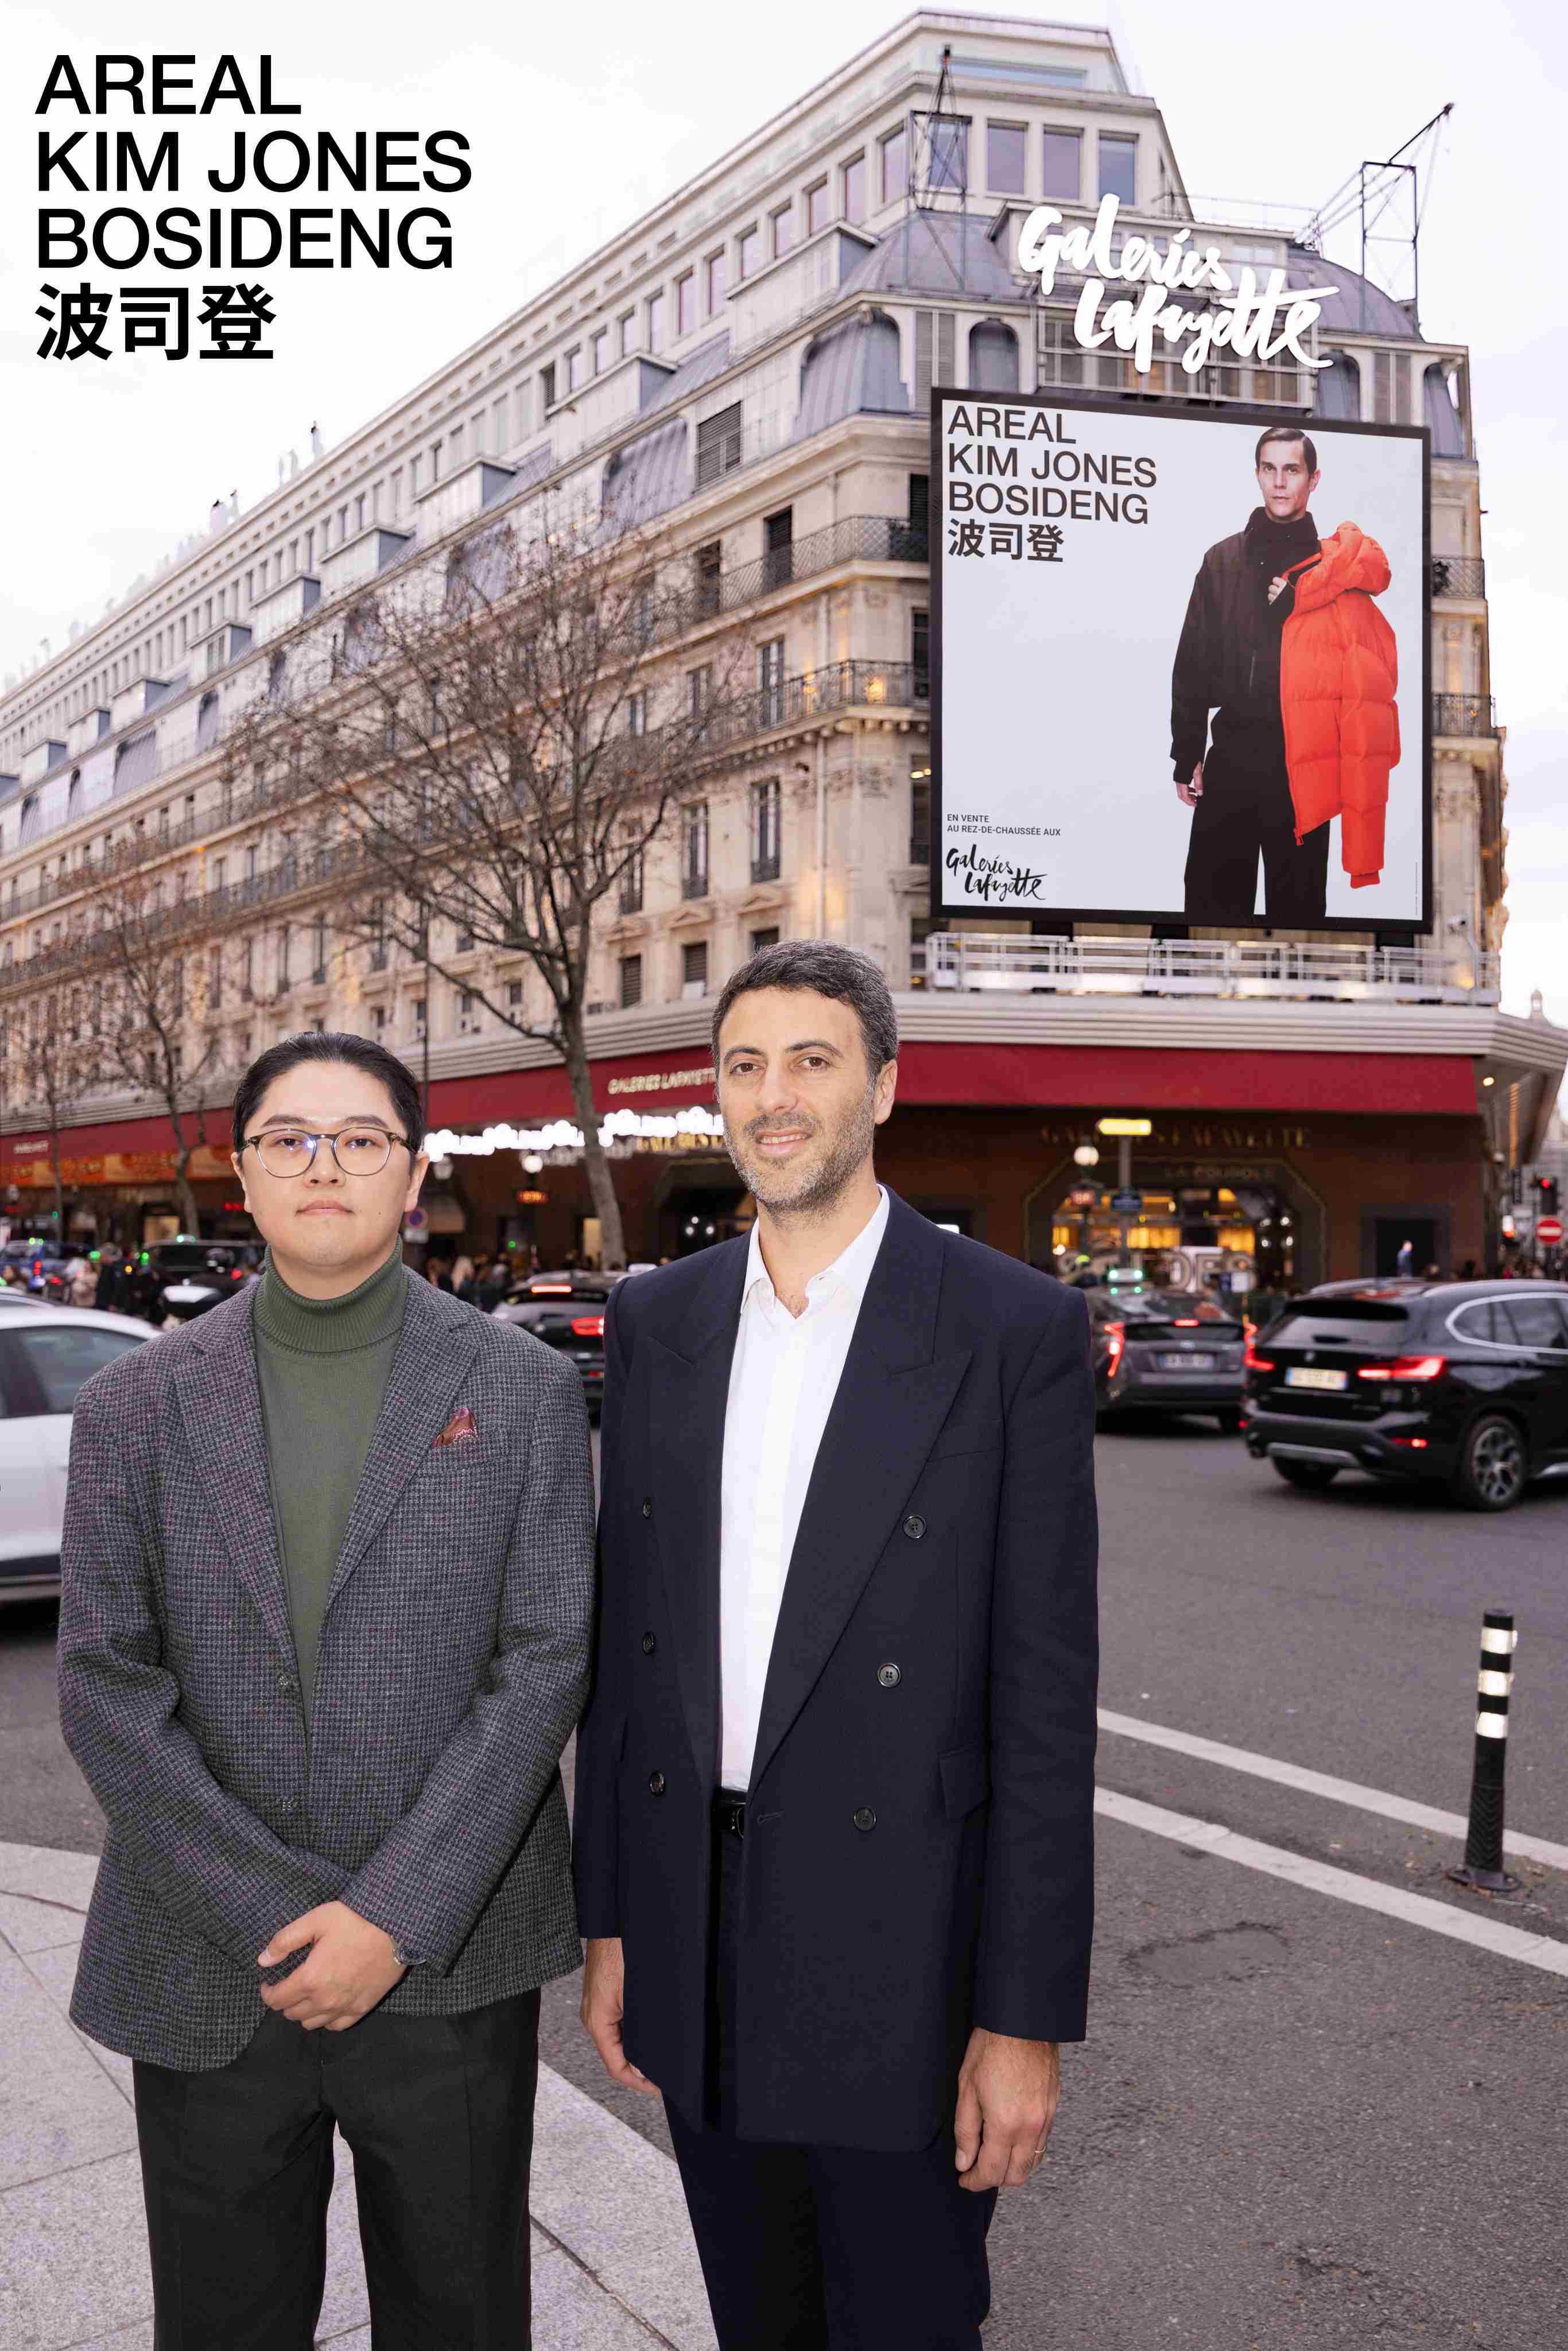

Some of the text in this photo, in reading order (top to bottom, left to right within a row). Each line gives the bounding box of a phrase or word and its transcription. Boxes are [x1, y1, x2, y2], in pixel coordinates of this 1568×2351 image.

[1018, 193, 1232, 294] Galeries
[1074, 267, 1340, 373] Lafayette
[948, 406, 1076, 444] AREAL
[949, 443, 1156, 488] KIM JONES
[949, 481, 1148, 524] BOSIDENG
[948, 518, 1064, 562] 波司登
[961, 814, 989, 823] VENTE
[961, 825, 1041, 835] REZ-DE-CHAUSSÉE
[946, 844, 1013, 877] Galeries
[964, 867, 1047, 902] Lafayette
[608, 1067, 716, 1095] GALERIES LAFAYETT
